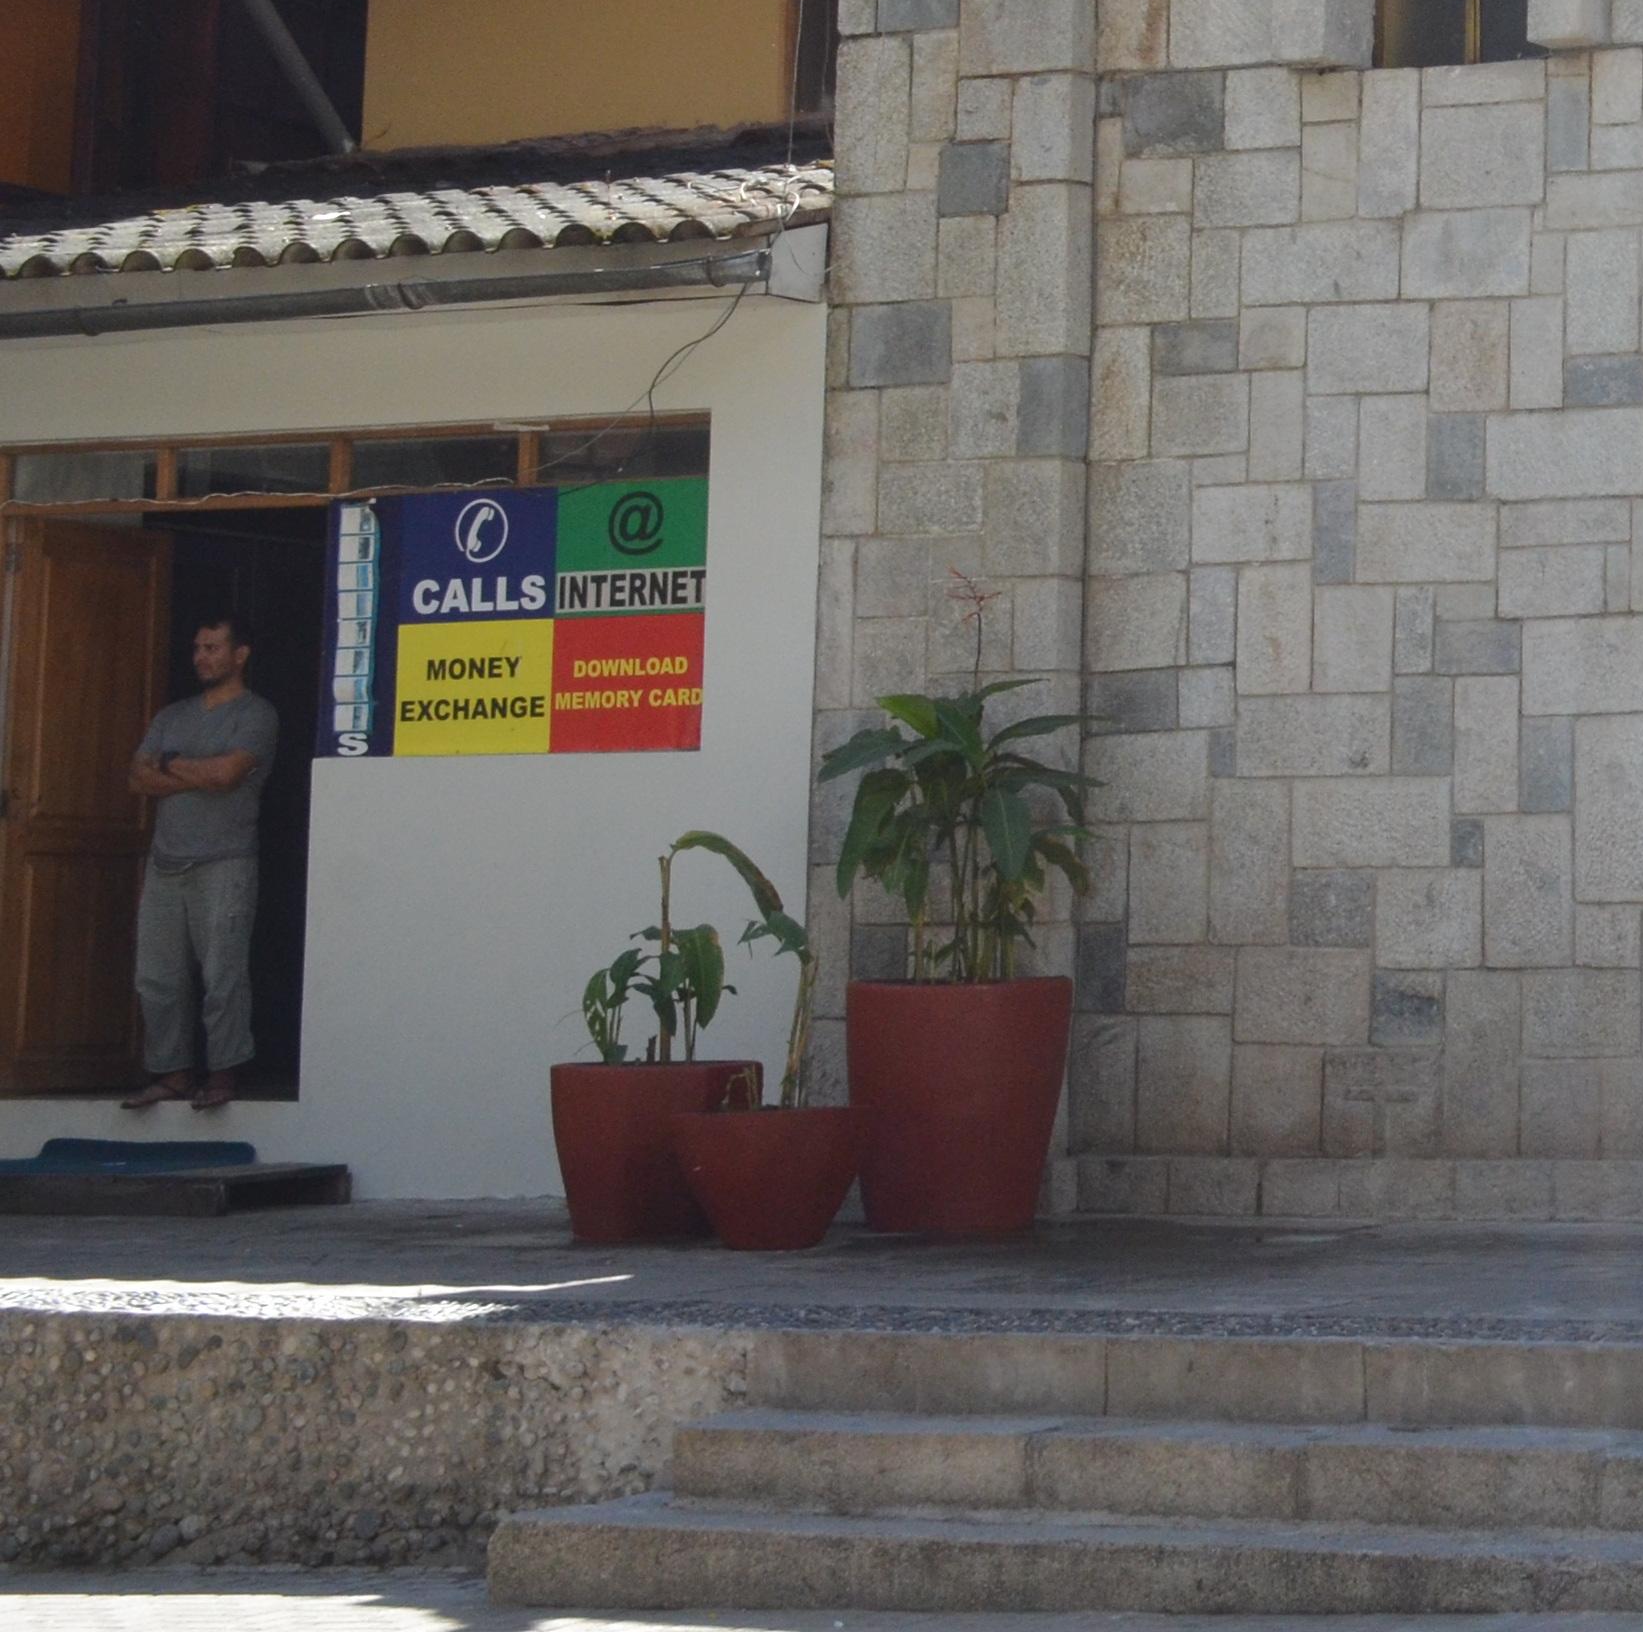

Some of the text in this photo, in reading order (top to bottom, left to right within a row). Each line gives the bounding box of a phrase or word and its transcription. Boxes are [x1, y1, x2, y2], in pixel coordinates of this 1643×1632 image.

[413, 575, 546, 615] CALLS
[559, 569, 707, 610] INTERNET
[426, 656, 521, 681] MONEY
[573, 657, 688, 678] DOWNLOAD
[400, 696, 545, 722] EXCHANGE
[555, 688, 702, 710] MEMORY CARD
